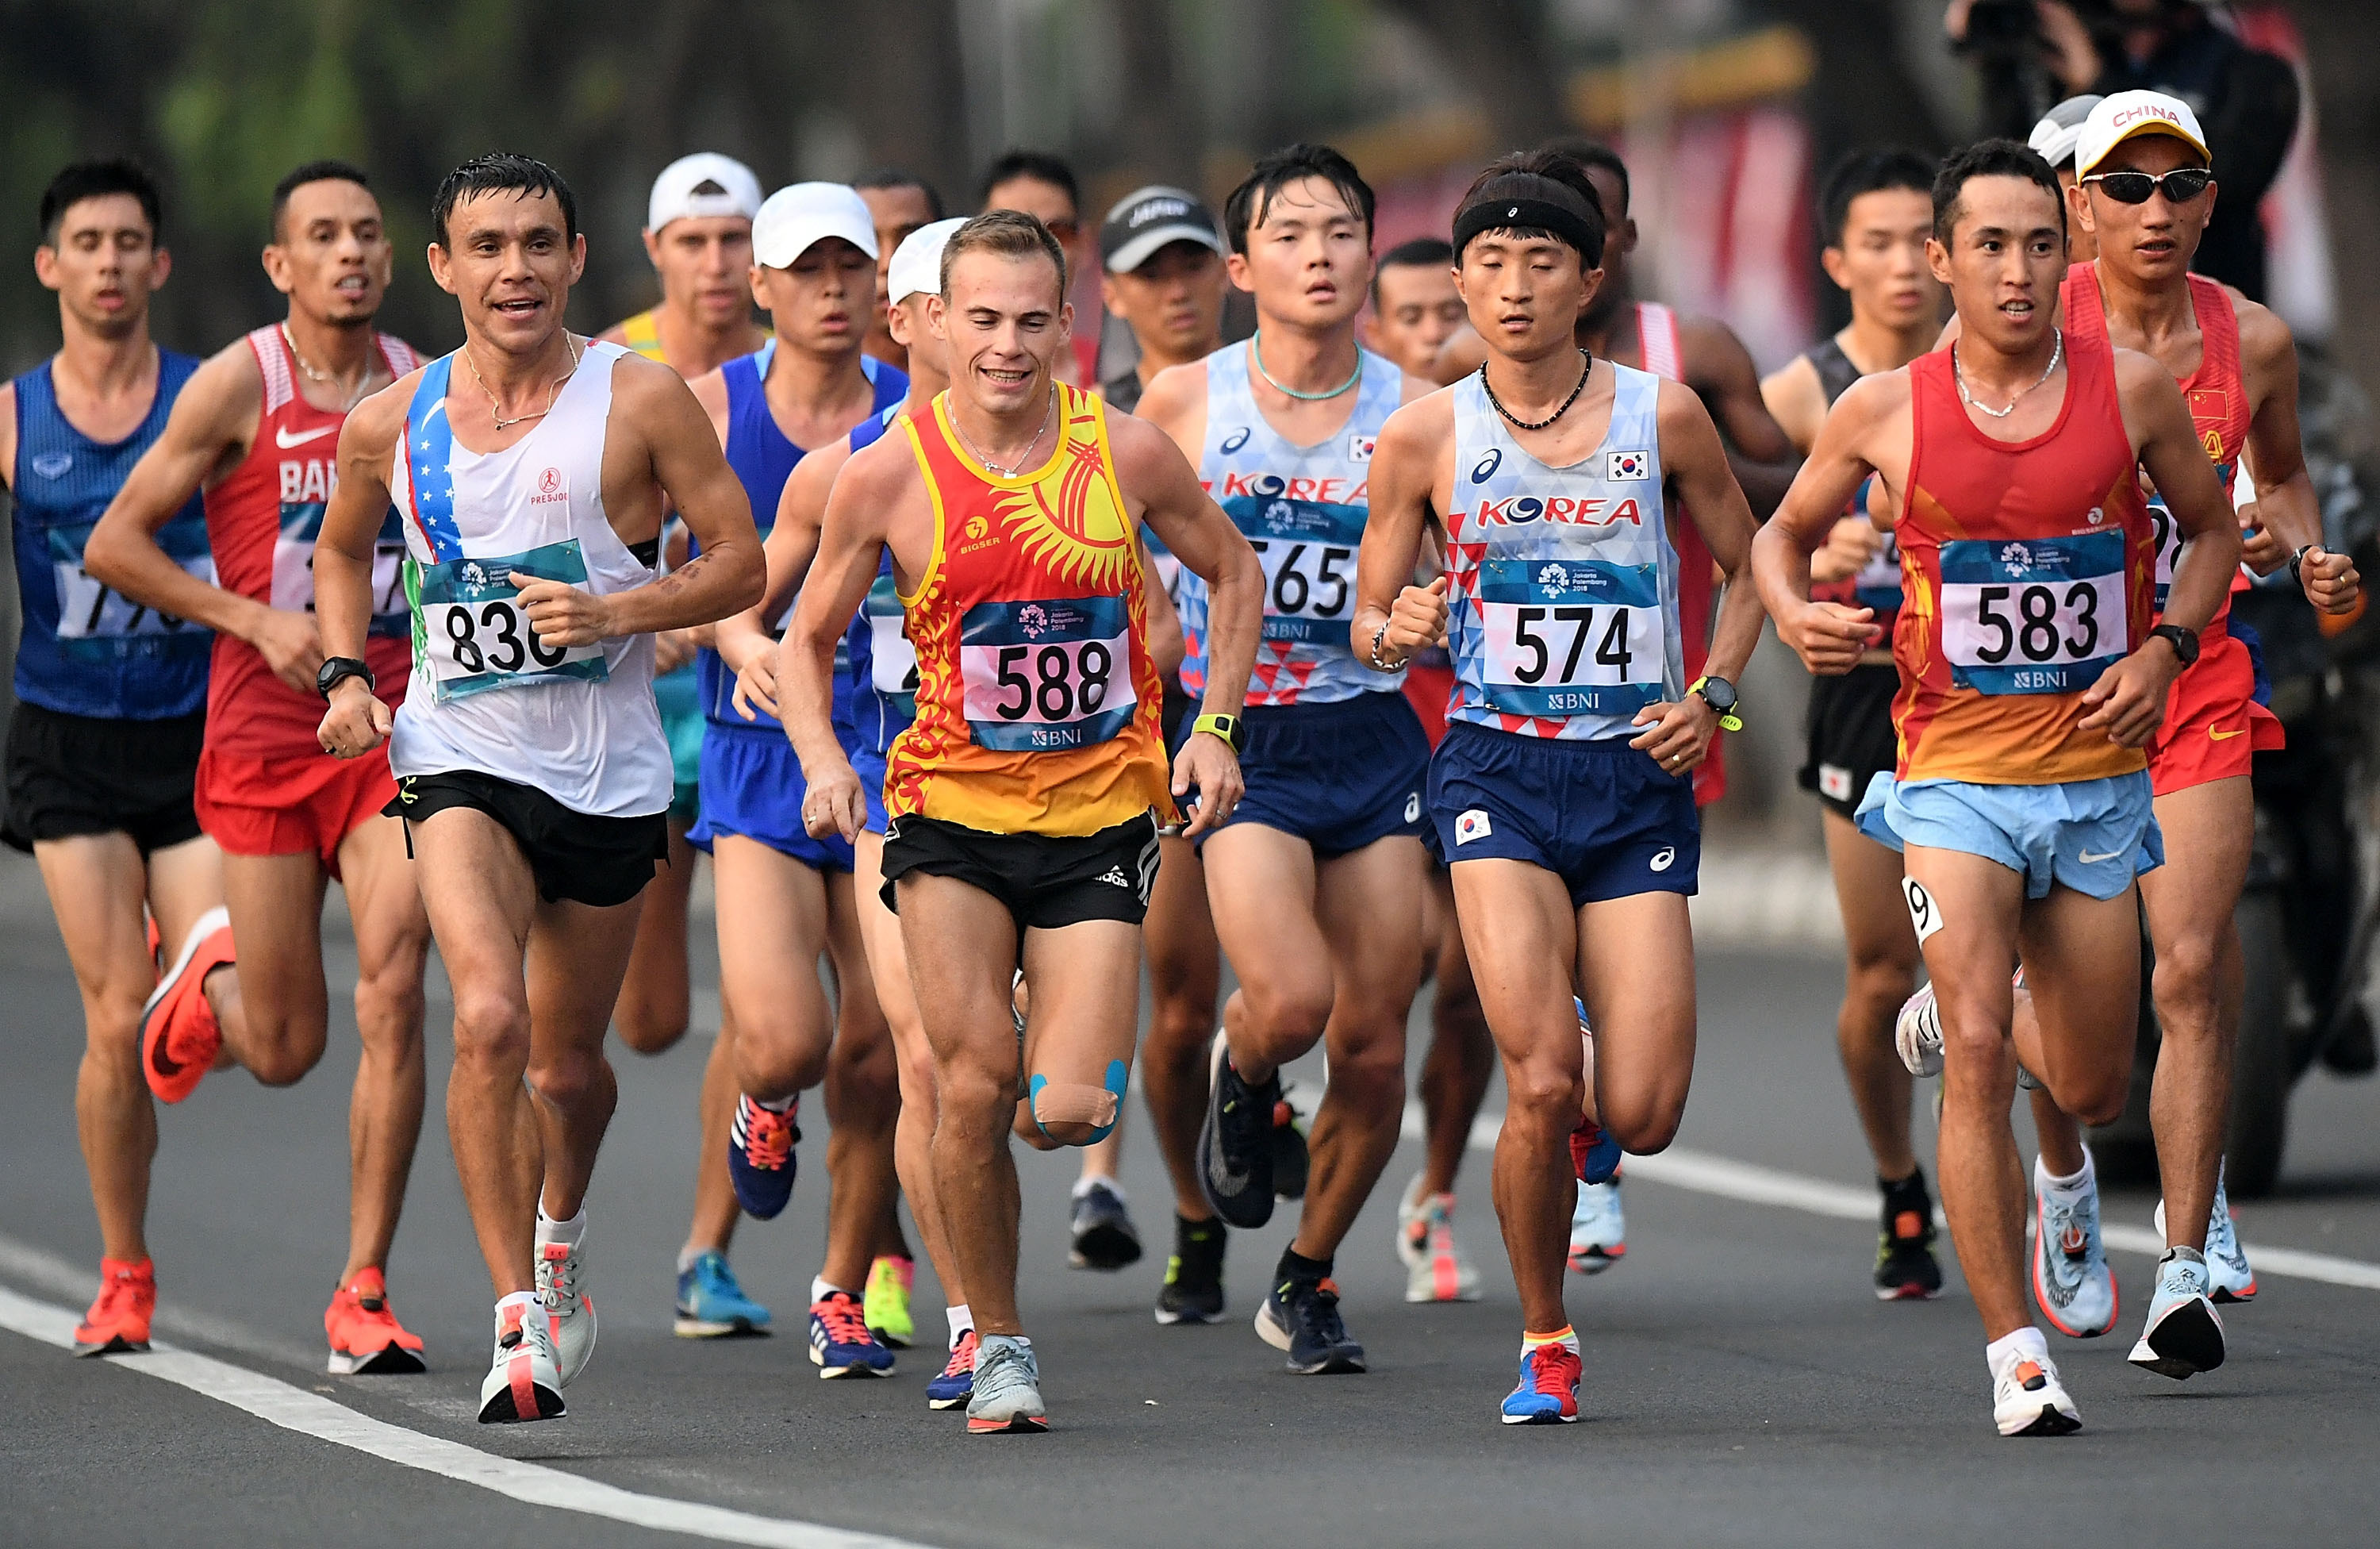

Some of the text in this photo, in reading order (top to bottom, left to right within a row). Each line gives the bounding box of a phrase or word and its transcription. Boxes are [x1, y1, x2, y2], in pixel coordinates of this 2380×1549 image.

[2112, 105, 2182, 128] CHINA
[1477, 497, 1641, 528] KOREA
[960, 536, 1000, 555] BIGSER
[1250, 541, 1350, 617] 65
[1279, 623, 1311, 640] BNI
[1976, 582, 2098, 663] 583
[1514, 607, 1633, 684] 574
[996, 641, 1112, 721] 588
[2033, 671, 2067, 688] BNI
[1566, 693, 1599, 709] BNI
[1050, 728, 1081, 746] BNI
[1909, 881, 1929, 931] 9
